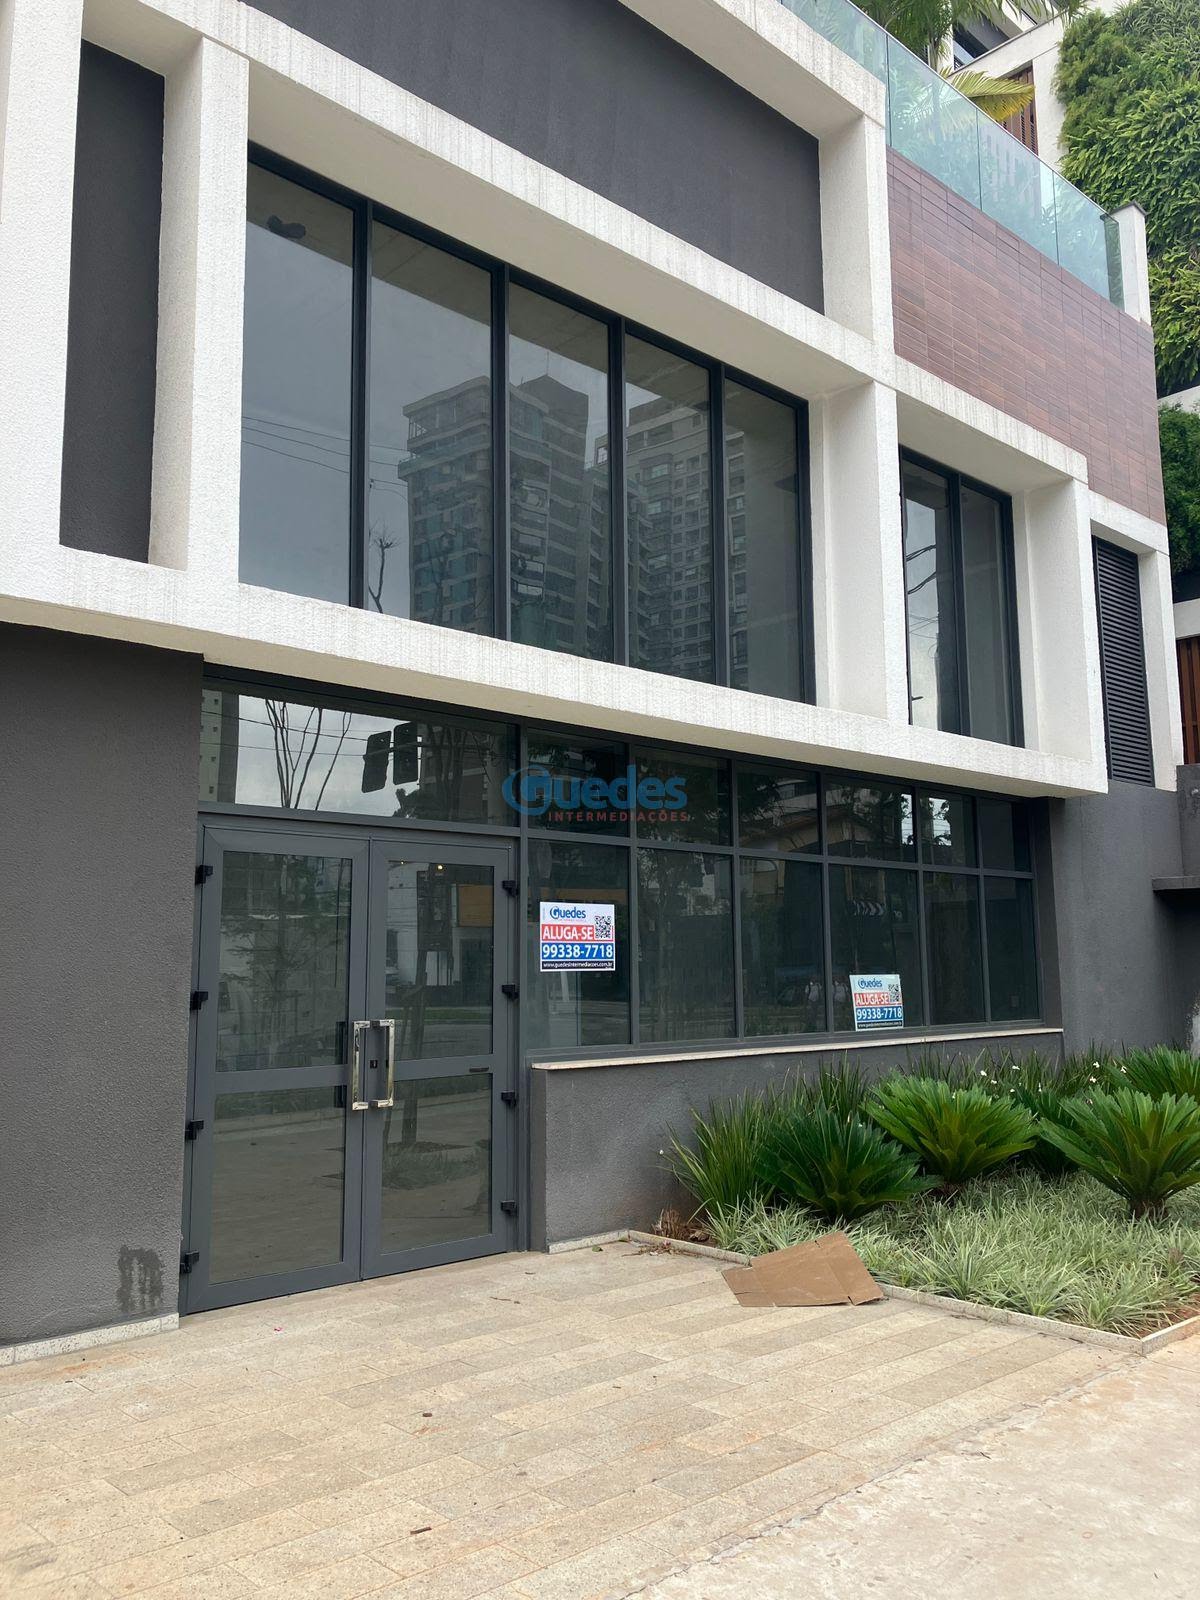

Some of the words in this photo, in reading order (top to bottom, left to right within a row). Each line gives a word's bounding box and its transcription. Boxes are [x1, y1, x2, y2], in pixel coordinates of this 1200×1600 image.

[550, 906, 586, 919] Guedes
[543, 926, 593, 940] ALUGA-SE
[543, 944, 613, 958] 99338-7718
[858, 978, 882, 989] Guedes
[855, 993, 889, 1006] ALUGA-SE
[857, 1007, 902, 1020] 99338-7718
